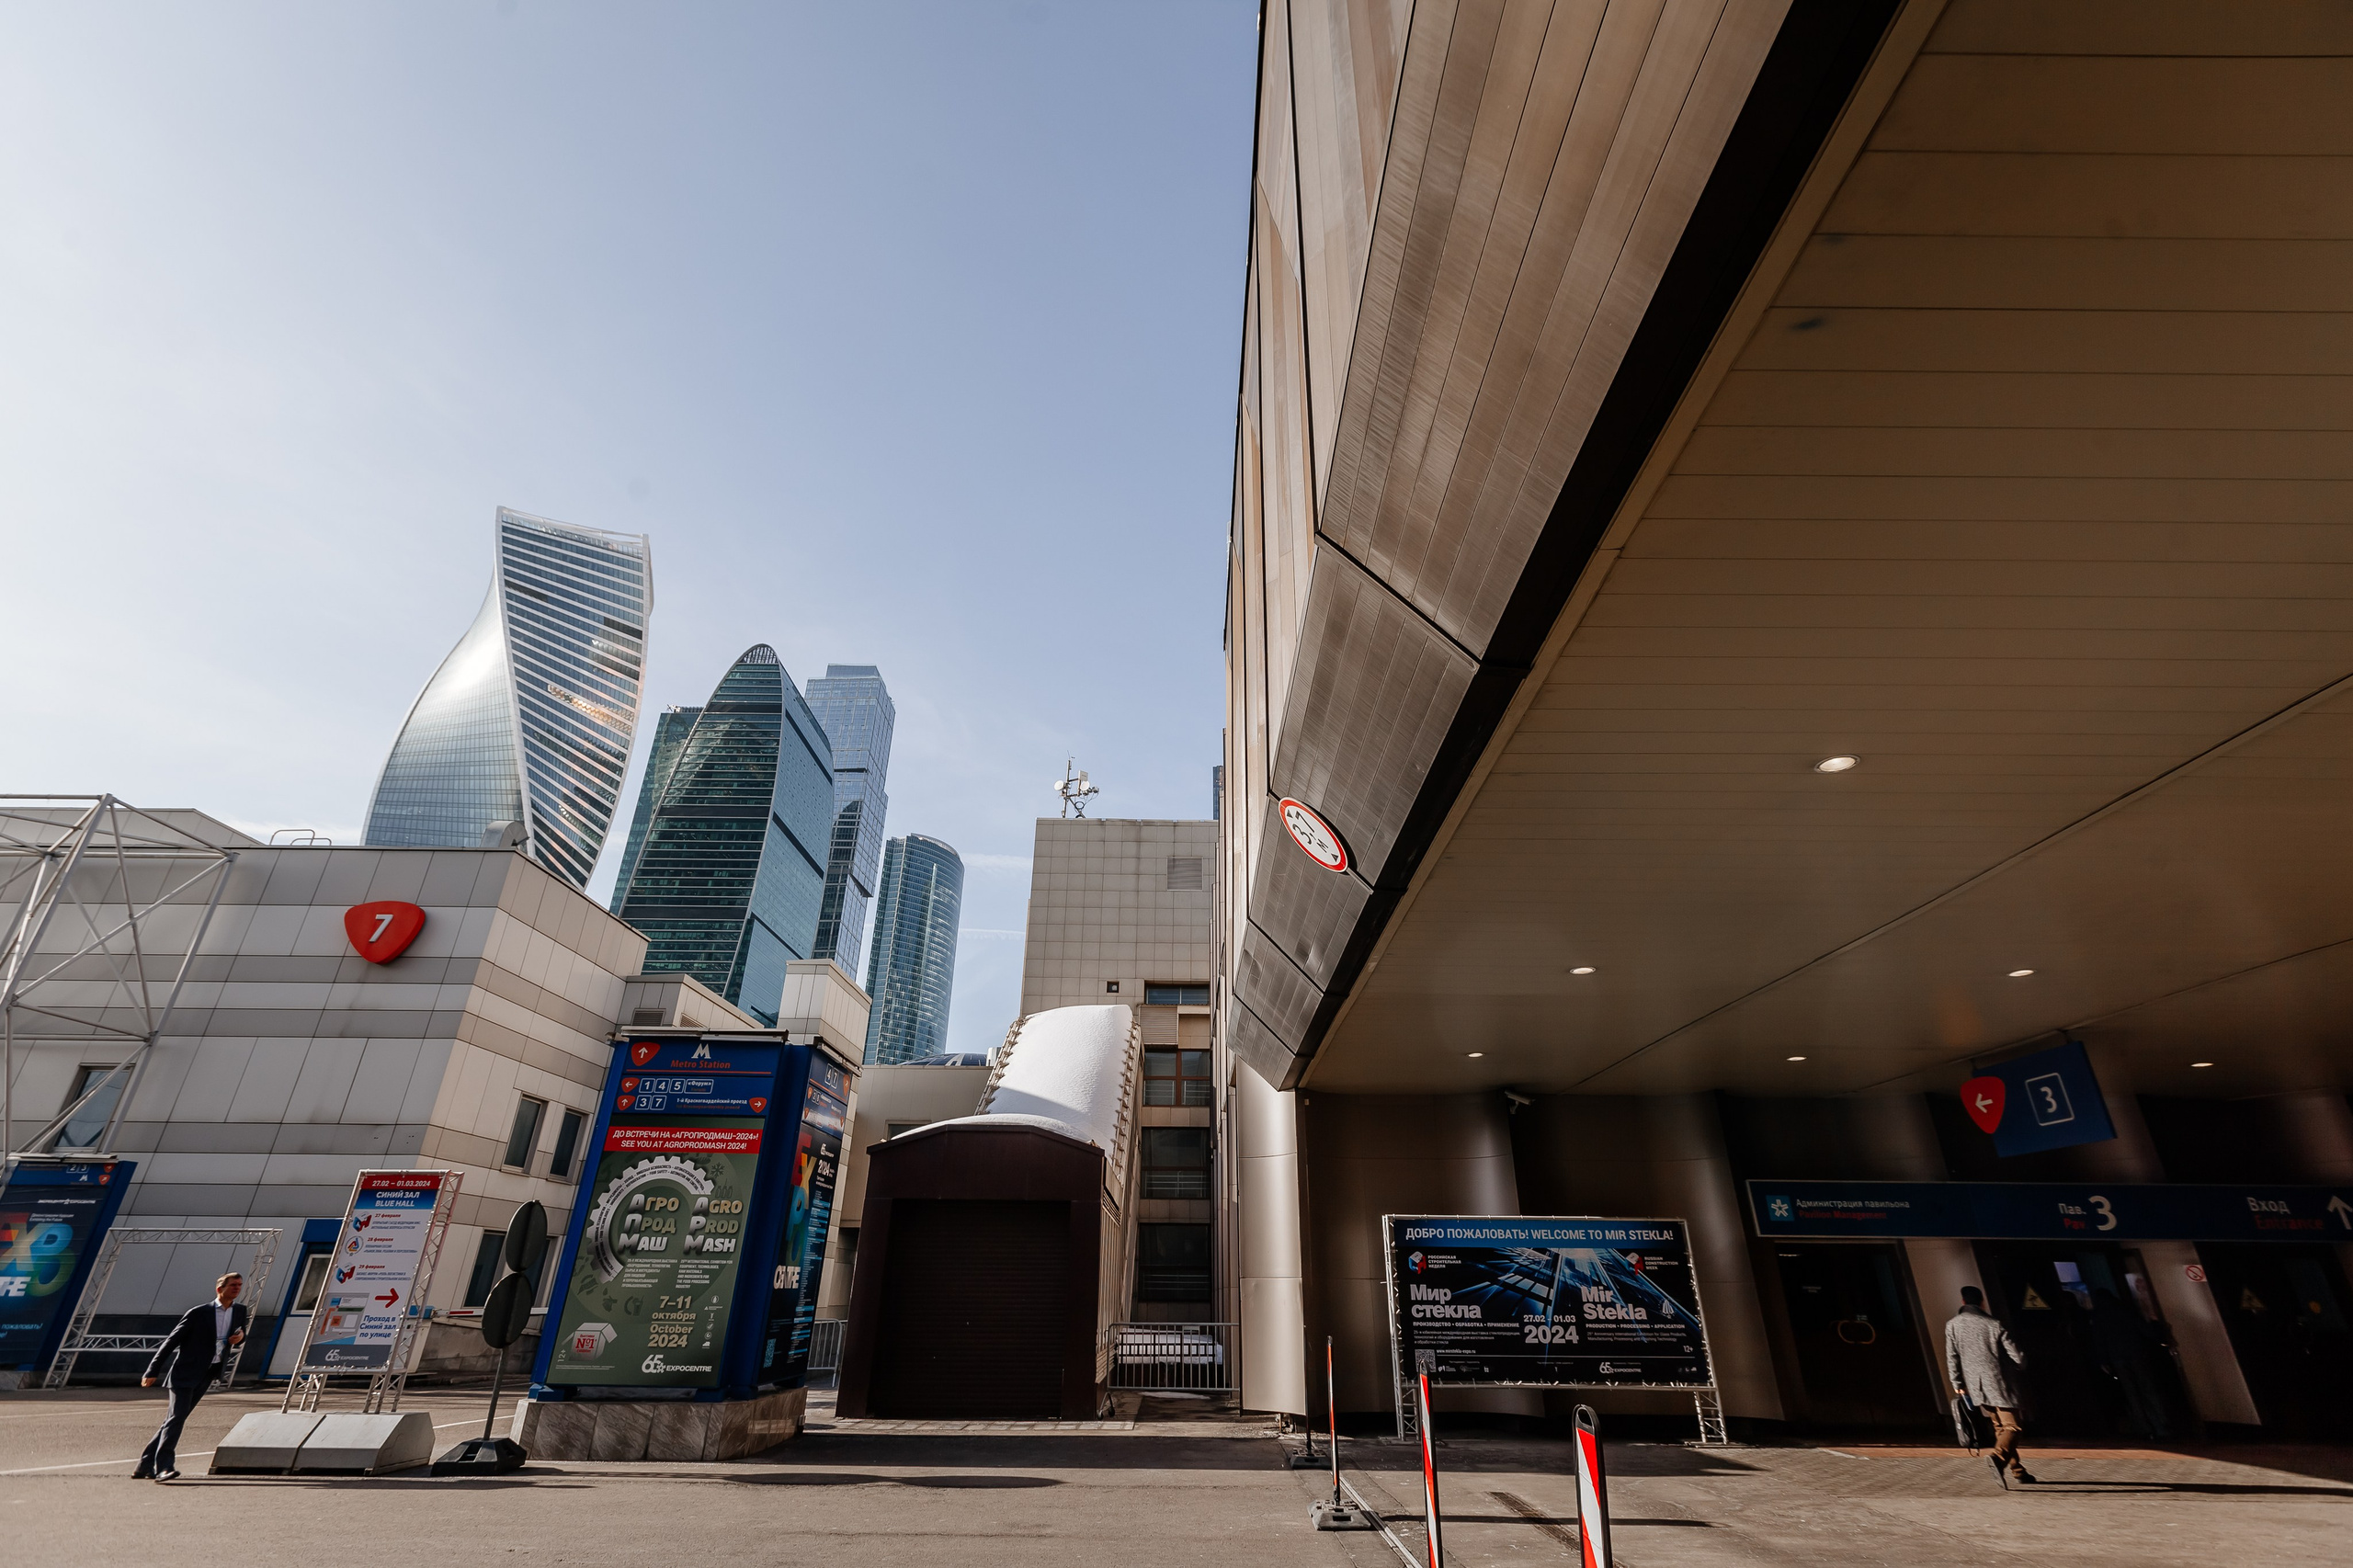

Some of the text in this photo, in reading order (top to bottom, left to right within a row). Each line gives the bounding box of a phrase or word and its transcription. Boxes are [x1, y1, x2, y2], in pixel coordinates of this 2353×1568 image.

[369, 914, 394, 943] 7
[670, 1060, 731, 1069] Metro Station
[644, 1081, 651, 1090] 1
[658, 1081, 665, 1090] 4
[674, 1082, 681, 1091] 5
[640, 1098, 663, 1107] 3 7
[2040, 1085, 2058, 1113] 3
[612, 1130, 625, 1139] ДО
[625, 1131, 659, 1139] ВСТРЕЧИ
[620, 1140, 636, 1148] SEE
[636, 1140, 652, 1148] YOU
[663, 1141, 726, 1149] AGROPRODMASH
[727, 1142, 747, 1150] 2024!
[376, 1190, 404, 1199] СИНИЙ
[628, 1193, 679, 1214] АГРО
[691, 1197, 744, 1216] AGRO
[1796, 1199, 1910, 1210] Администрация павильона
[2246, 1197, 2291, 1214] Вход
[2058, 1195, 2118, 1232] Пав. 3
[623, 1213, 676, 1234] ПРОД
[688, 1215, 739, 1235] PROD
[1405, 1228, 1674, 1241] ДОБРО ПОЖАЛОВАТЬ! WELCOME TO MIR STEKLA!
[617, 1233, 668, 1256] МАШ
[683, 1234, 736, 1256] MASH
[1409, 1284, 1452, 1304] Мир
[1581, 1286, 1614, 1302] Mir
[652, 1311, 696, 1322] октября
[1411, 1304, 1482, 1319] стекла
[1523, 1314, 1546, 1323] 27.02
[1583, 1303, 1648, 1321] Stekla
[363, 1315, 390, 1324] Проход
[650, 1324, 693, 1334] October
[1524, 1324, 1579, 1345] 2024
[647, 1335, 688, 1348] 2024
[1683, 1345, 1693, 1353] 12+
